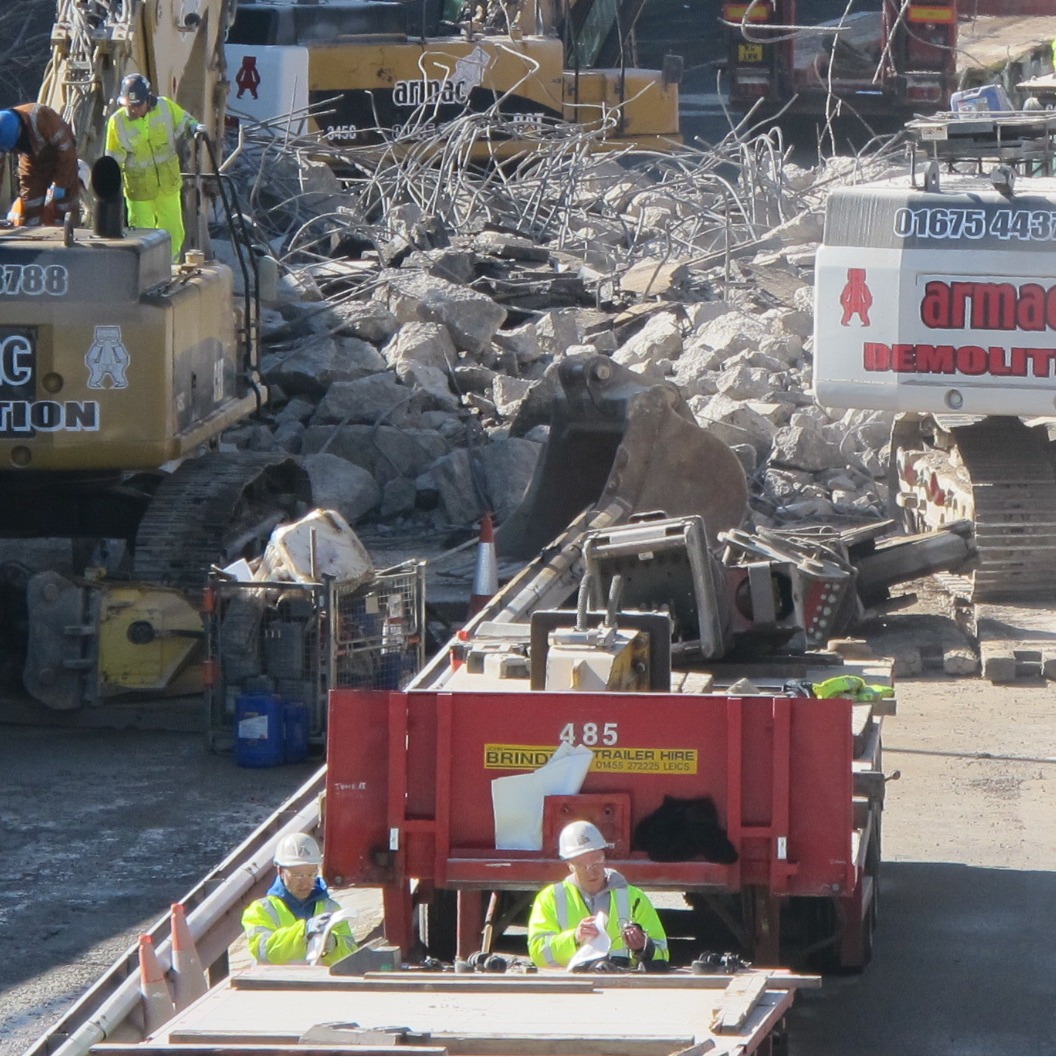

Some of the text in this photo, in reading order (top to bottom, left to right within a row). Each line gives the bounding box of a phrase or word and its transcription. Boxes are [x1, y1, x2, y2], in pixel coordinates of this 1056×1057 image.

[392, 80, 470, 106] armac
[893, 207, 986, 240] 01675
[0, 264, 68, 295] 788
[559, 722, 619, 746] 485
[486, 750, 694, 765] BRIND TRAILER HIRE
[596, 761, 690, 771] 01455 272225 LEICS
